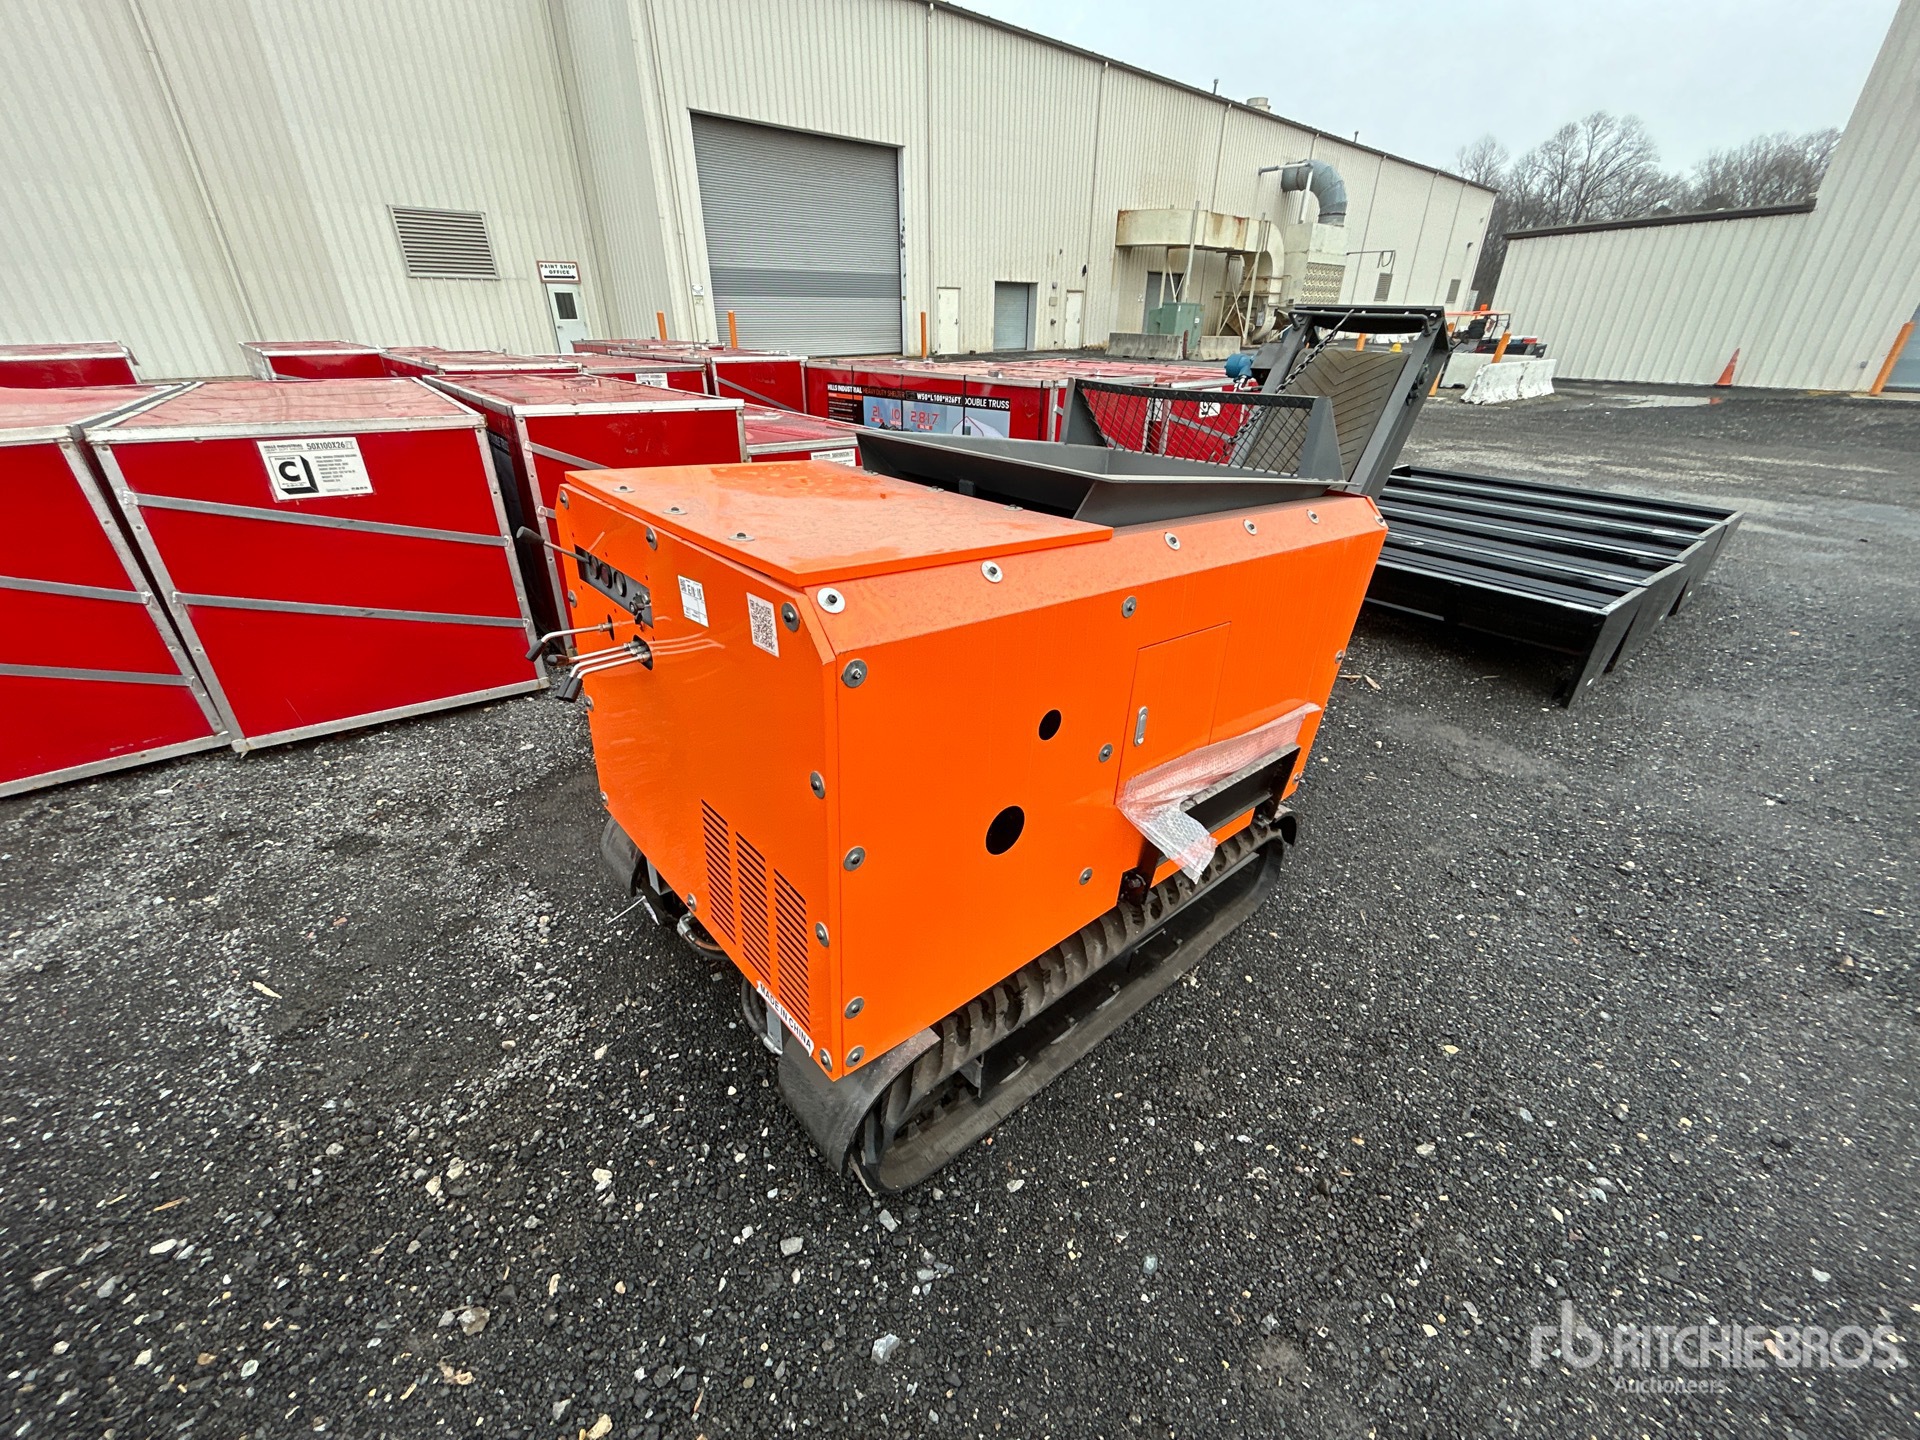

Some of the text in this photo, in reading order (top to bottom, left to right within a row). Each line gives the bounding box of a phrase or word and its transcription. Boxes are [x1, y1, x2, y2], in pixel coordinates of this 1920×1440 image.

[827, 383, 838, 391] HILLS
[838, 385, 863, 394] INDUSTRIAL
[988, 399, 1010, 409] TRUSS
[279, 460, 301, 482] C
[760, 983, 812, 1051] MADE IN CHINA
